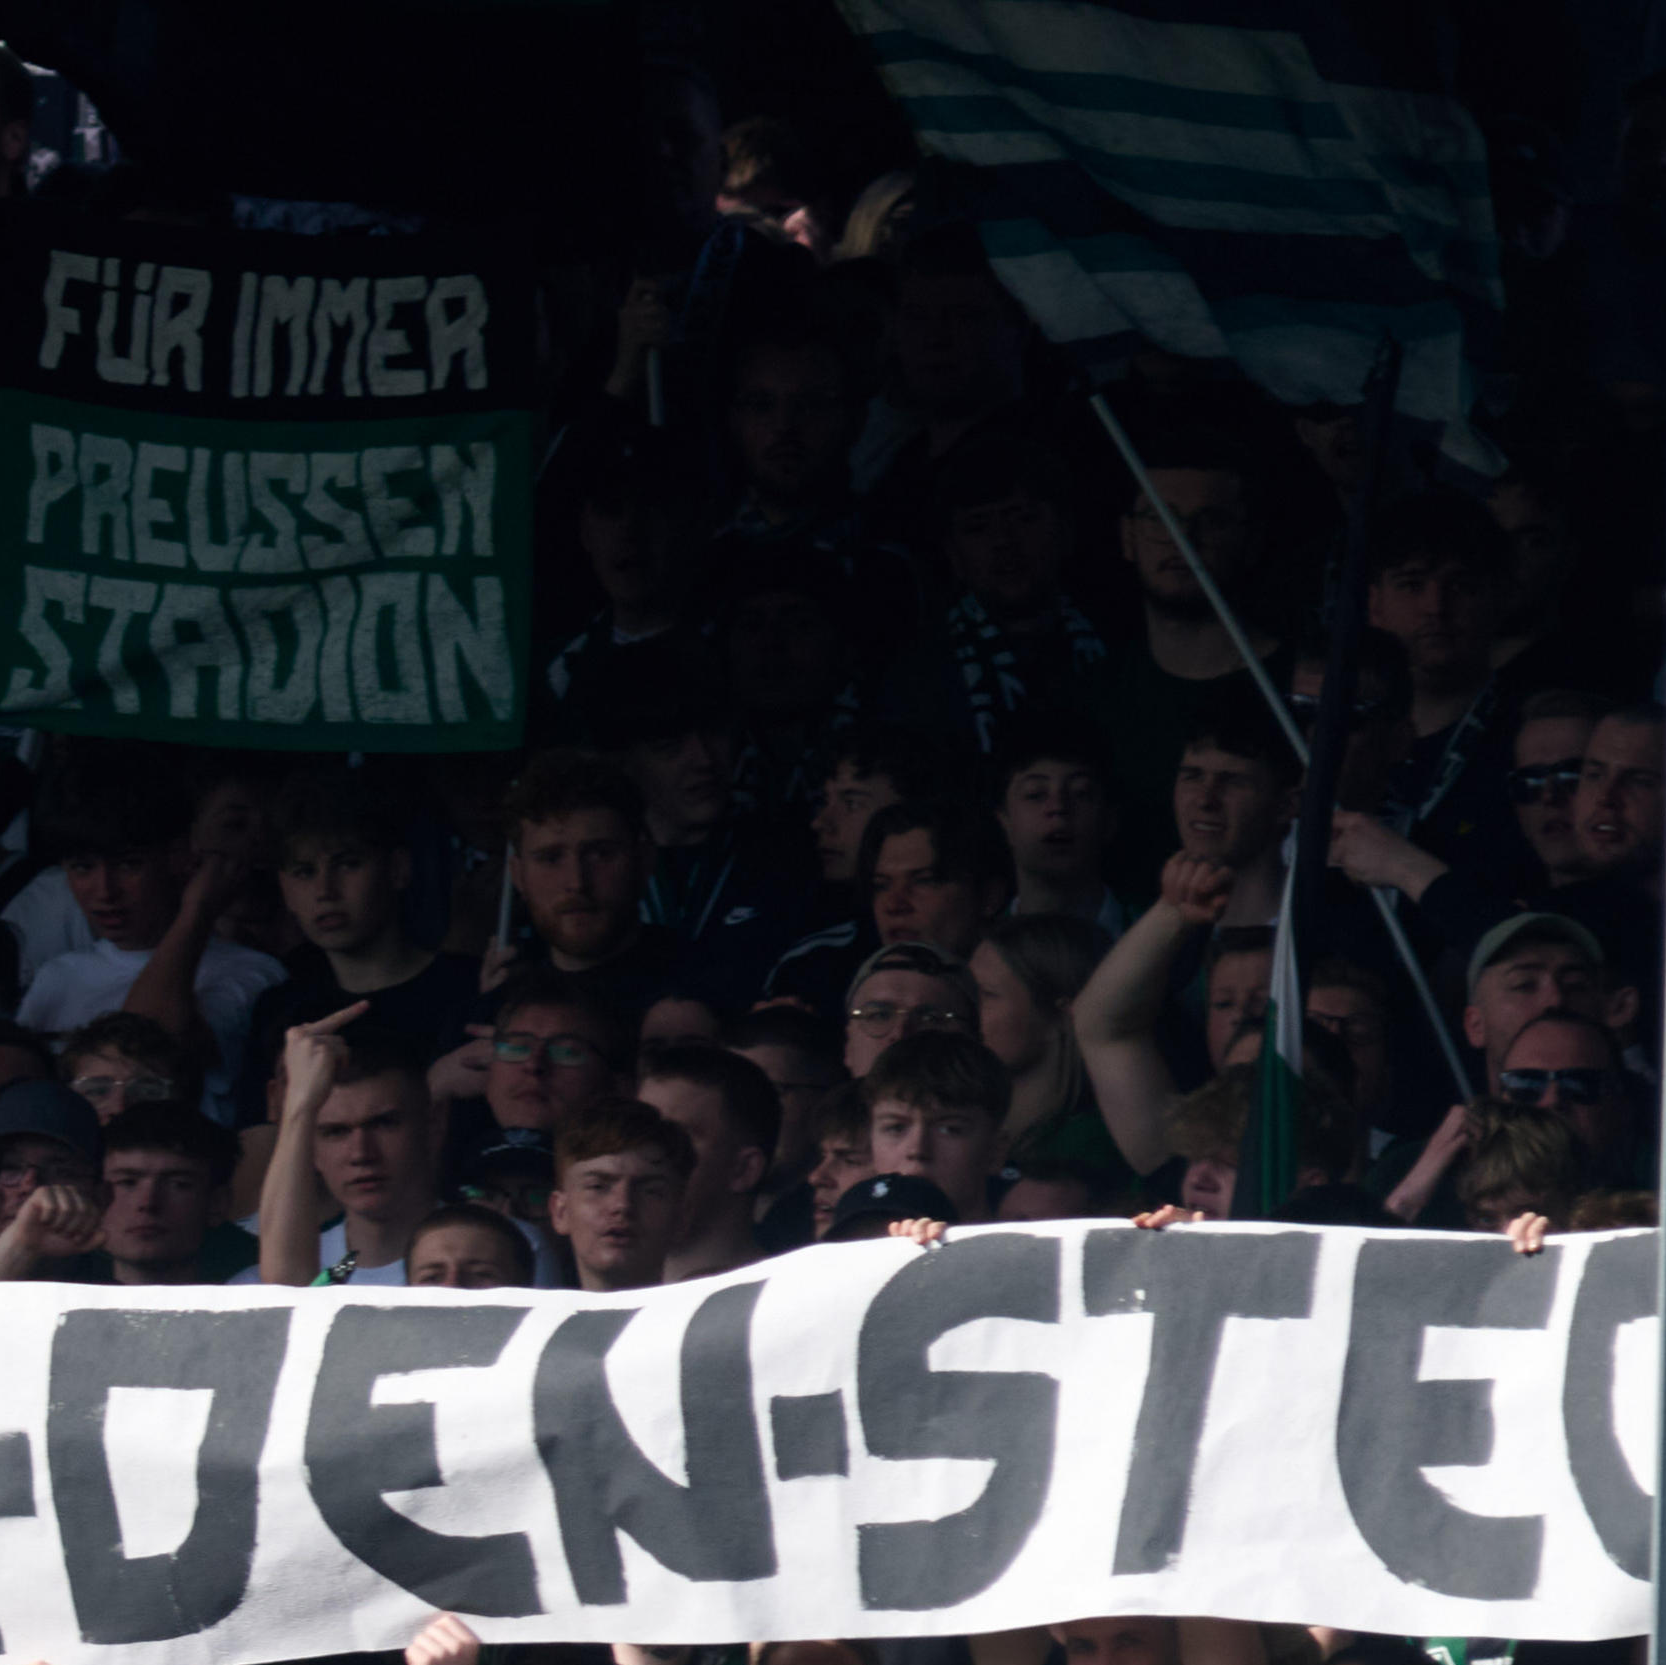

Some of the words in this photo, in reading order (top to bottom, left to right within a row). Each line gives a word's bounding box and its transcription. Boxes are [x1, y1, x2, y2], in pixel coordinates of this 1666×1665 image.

[40, 251, 212, 392] FÜR
[231, 272, 490, 398] IMMER
[28, 423, 496, 574] PREUSSEN
[0, 565, 515, 724] STADION
